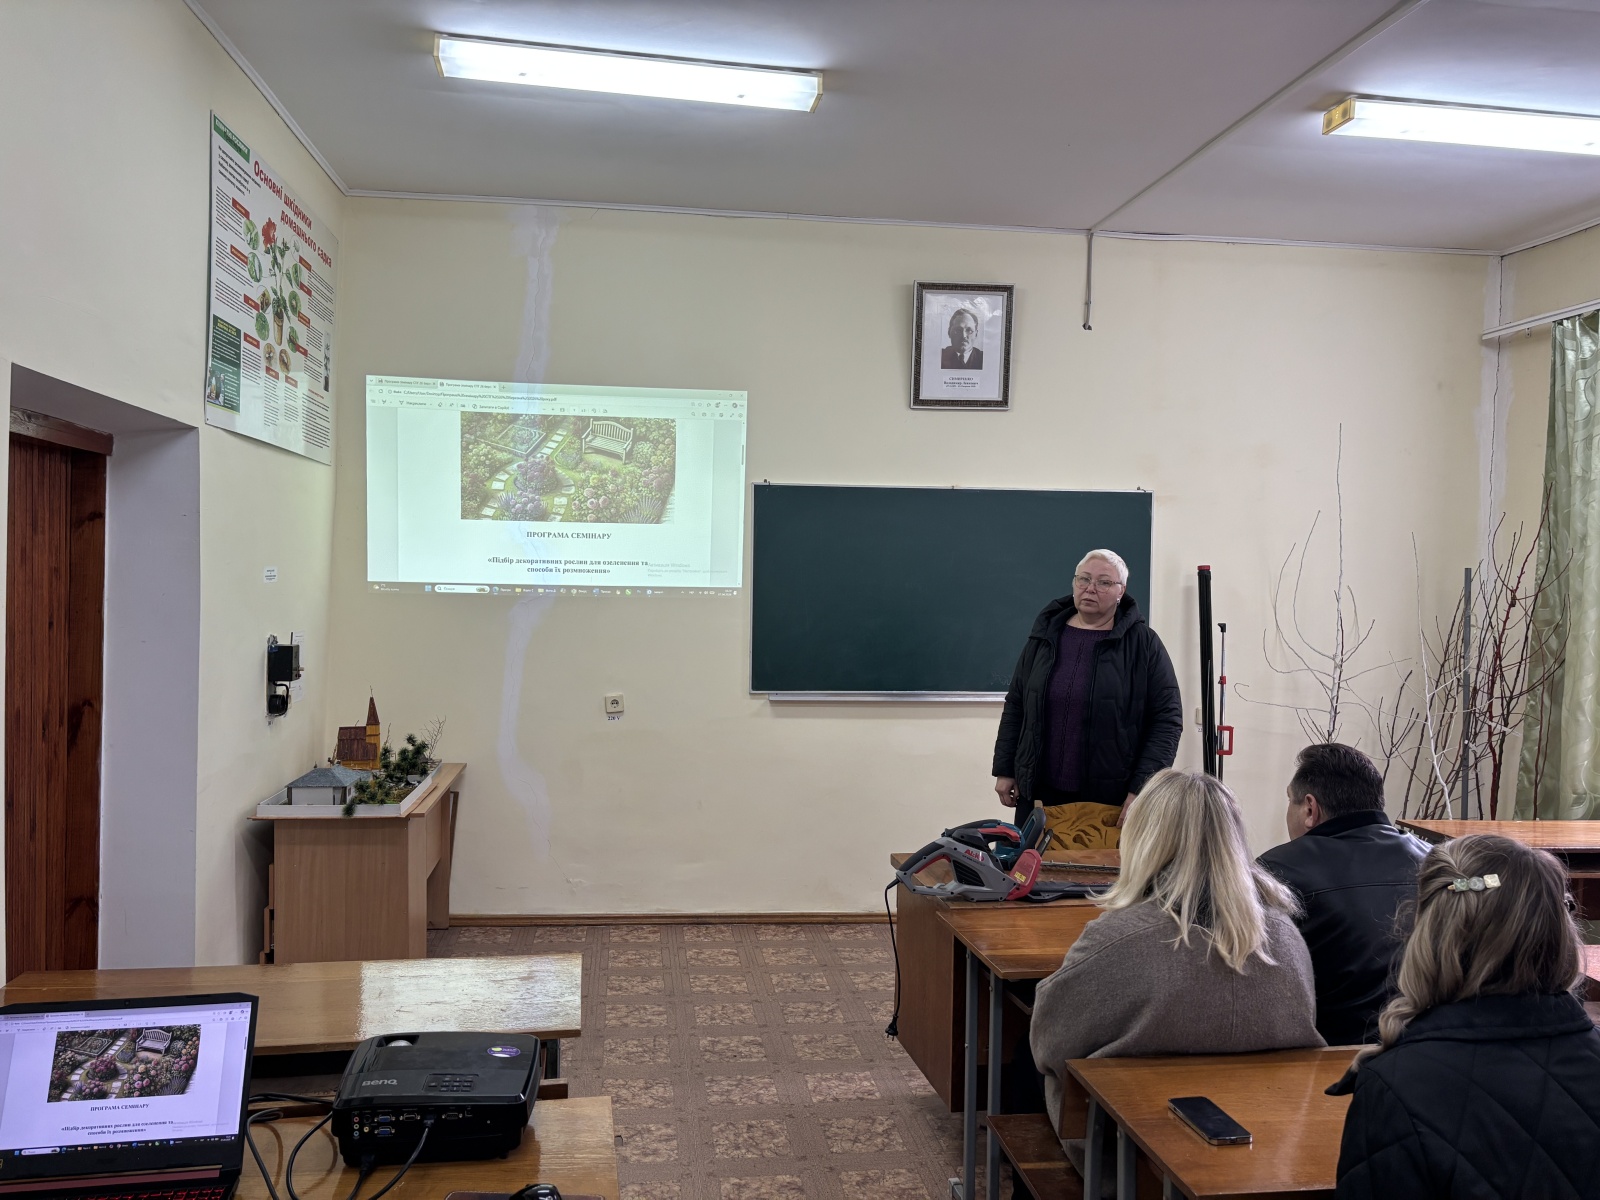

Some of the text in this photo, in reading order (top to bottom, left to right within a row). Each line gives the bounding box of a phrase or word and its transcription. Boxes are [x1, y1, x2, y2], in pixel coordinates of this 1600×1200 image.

[253, 160, 283, 202] Основні
[283, 191, 312, 231] шкідники
[280, 211, 317, 253] домашнього
[526, 531, 612, 540] ПРОГРАМА СЕМІНАРУ
[487, 556, 514, 566] «Підбір
[515, 558, 563, 567] декоративних
[564, 559, 587, 568] рослин
[588, 560, 601, 568] для
[526, 566, 611, 575] способи їх розмноження»
